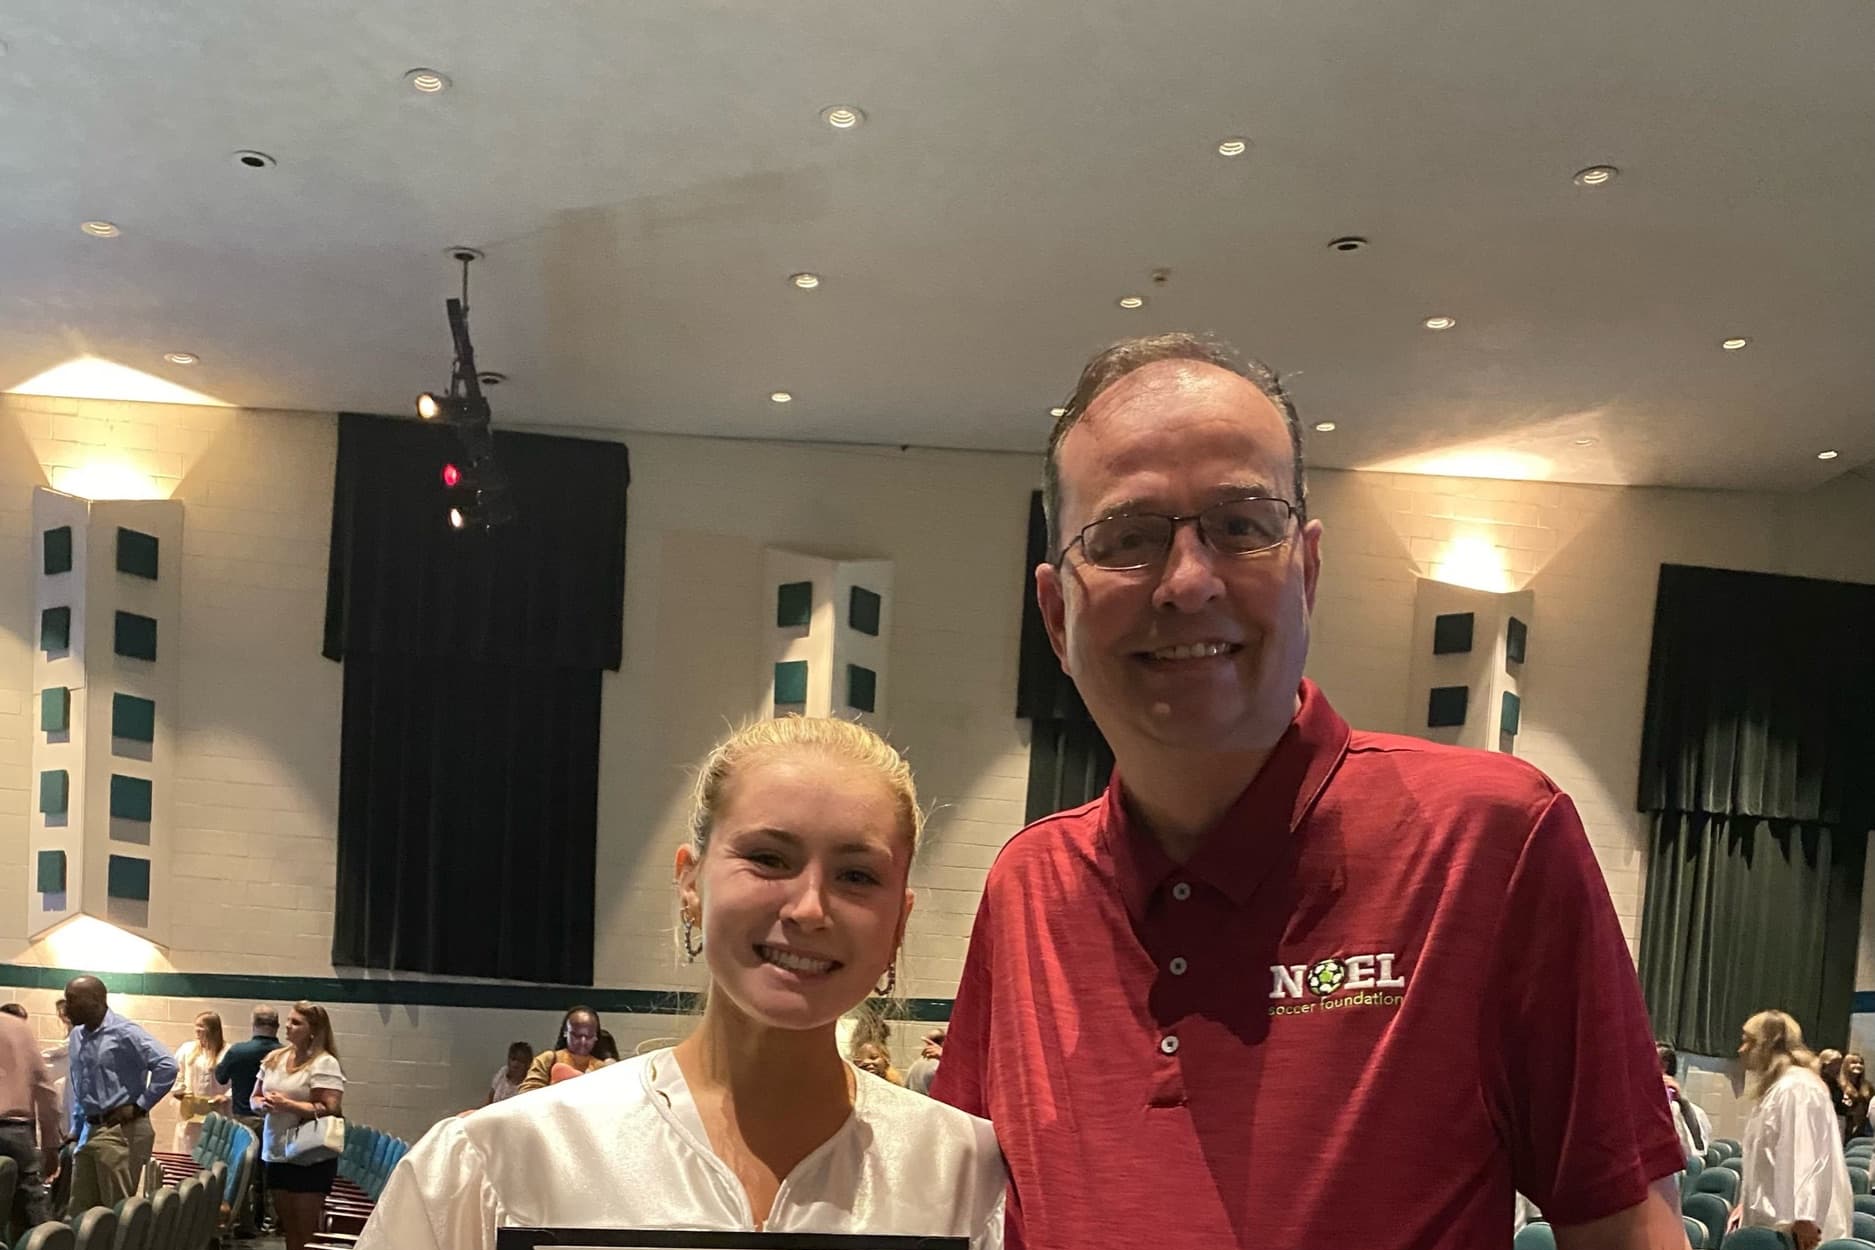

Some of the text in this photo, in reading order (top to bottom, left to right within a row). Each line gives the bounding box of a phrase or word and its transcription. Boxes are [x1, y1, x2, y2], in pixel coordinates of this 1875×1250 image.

[1268, 952, 1406, 999] NOEL
[1267, 991, 1404, 1016] soccer foundation
